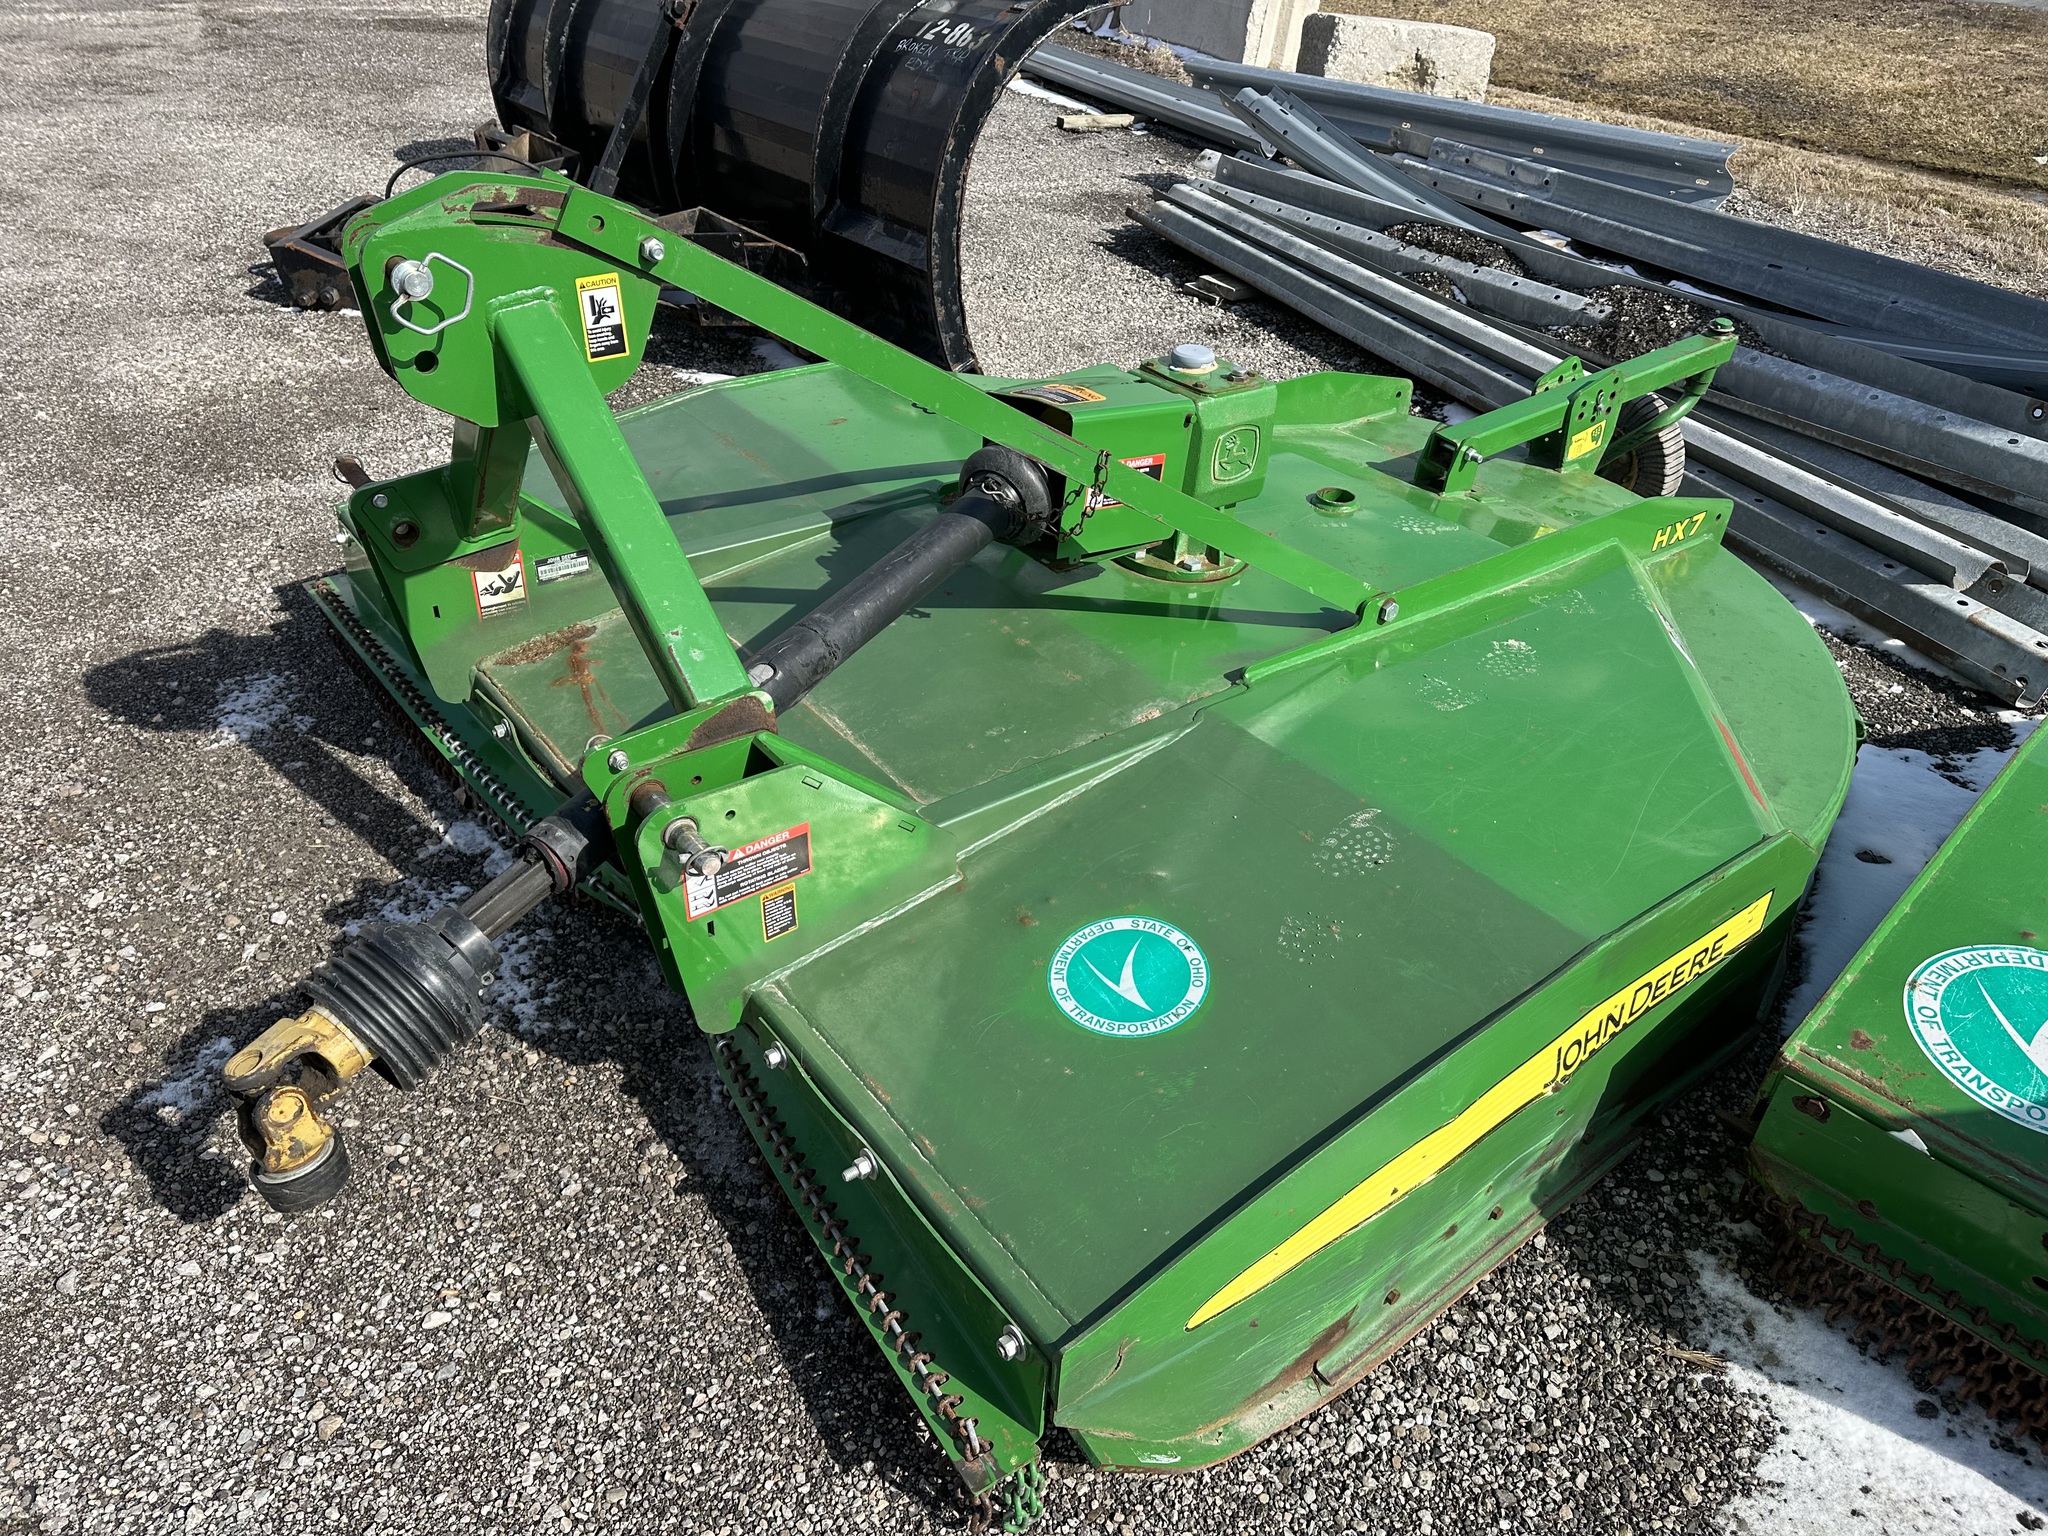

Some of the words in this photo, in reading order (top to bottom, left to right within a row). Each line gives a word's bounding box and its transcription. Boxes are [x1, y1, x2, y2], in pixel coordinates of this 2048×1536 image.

[894, 37, 939, 57] BROKEN
[585, 277, 617, 288] CAUTION
[1651, 510, 1708, 552] HX7
[737, 854, 762, 866] THROWN
[762, 843, 787, 856] OBJECTS
[745, 831, 790, 854] DANGER
[740, 874, 766, 888] ROTATING
[767, 865, 788, 876] BLADES
[769, 883, 795, 898] WARNING
[1053, 921, 1114, 982] DEPARTMENT
[1130, 919, 1175, 939] STATE
[1176, 938, 1196, 954] OF
[1189, 957, 1204, 988] OHIO
[1918, 952, 2045, 1001] DEPARTMENT
[1056, 987, 1072, 1003] OF
[1069, 998, 1196, 1034] TRANSPORTATION
[1543, 1002, 1626, 1089] JOHN
[1628, 932, 1729, 1019] DEERE
[1917, 1005, 1942, 1031] OF
